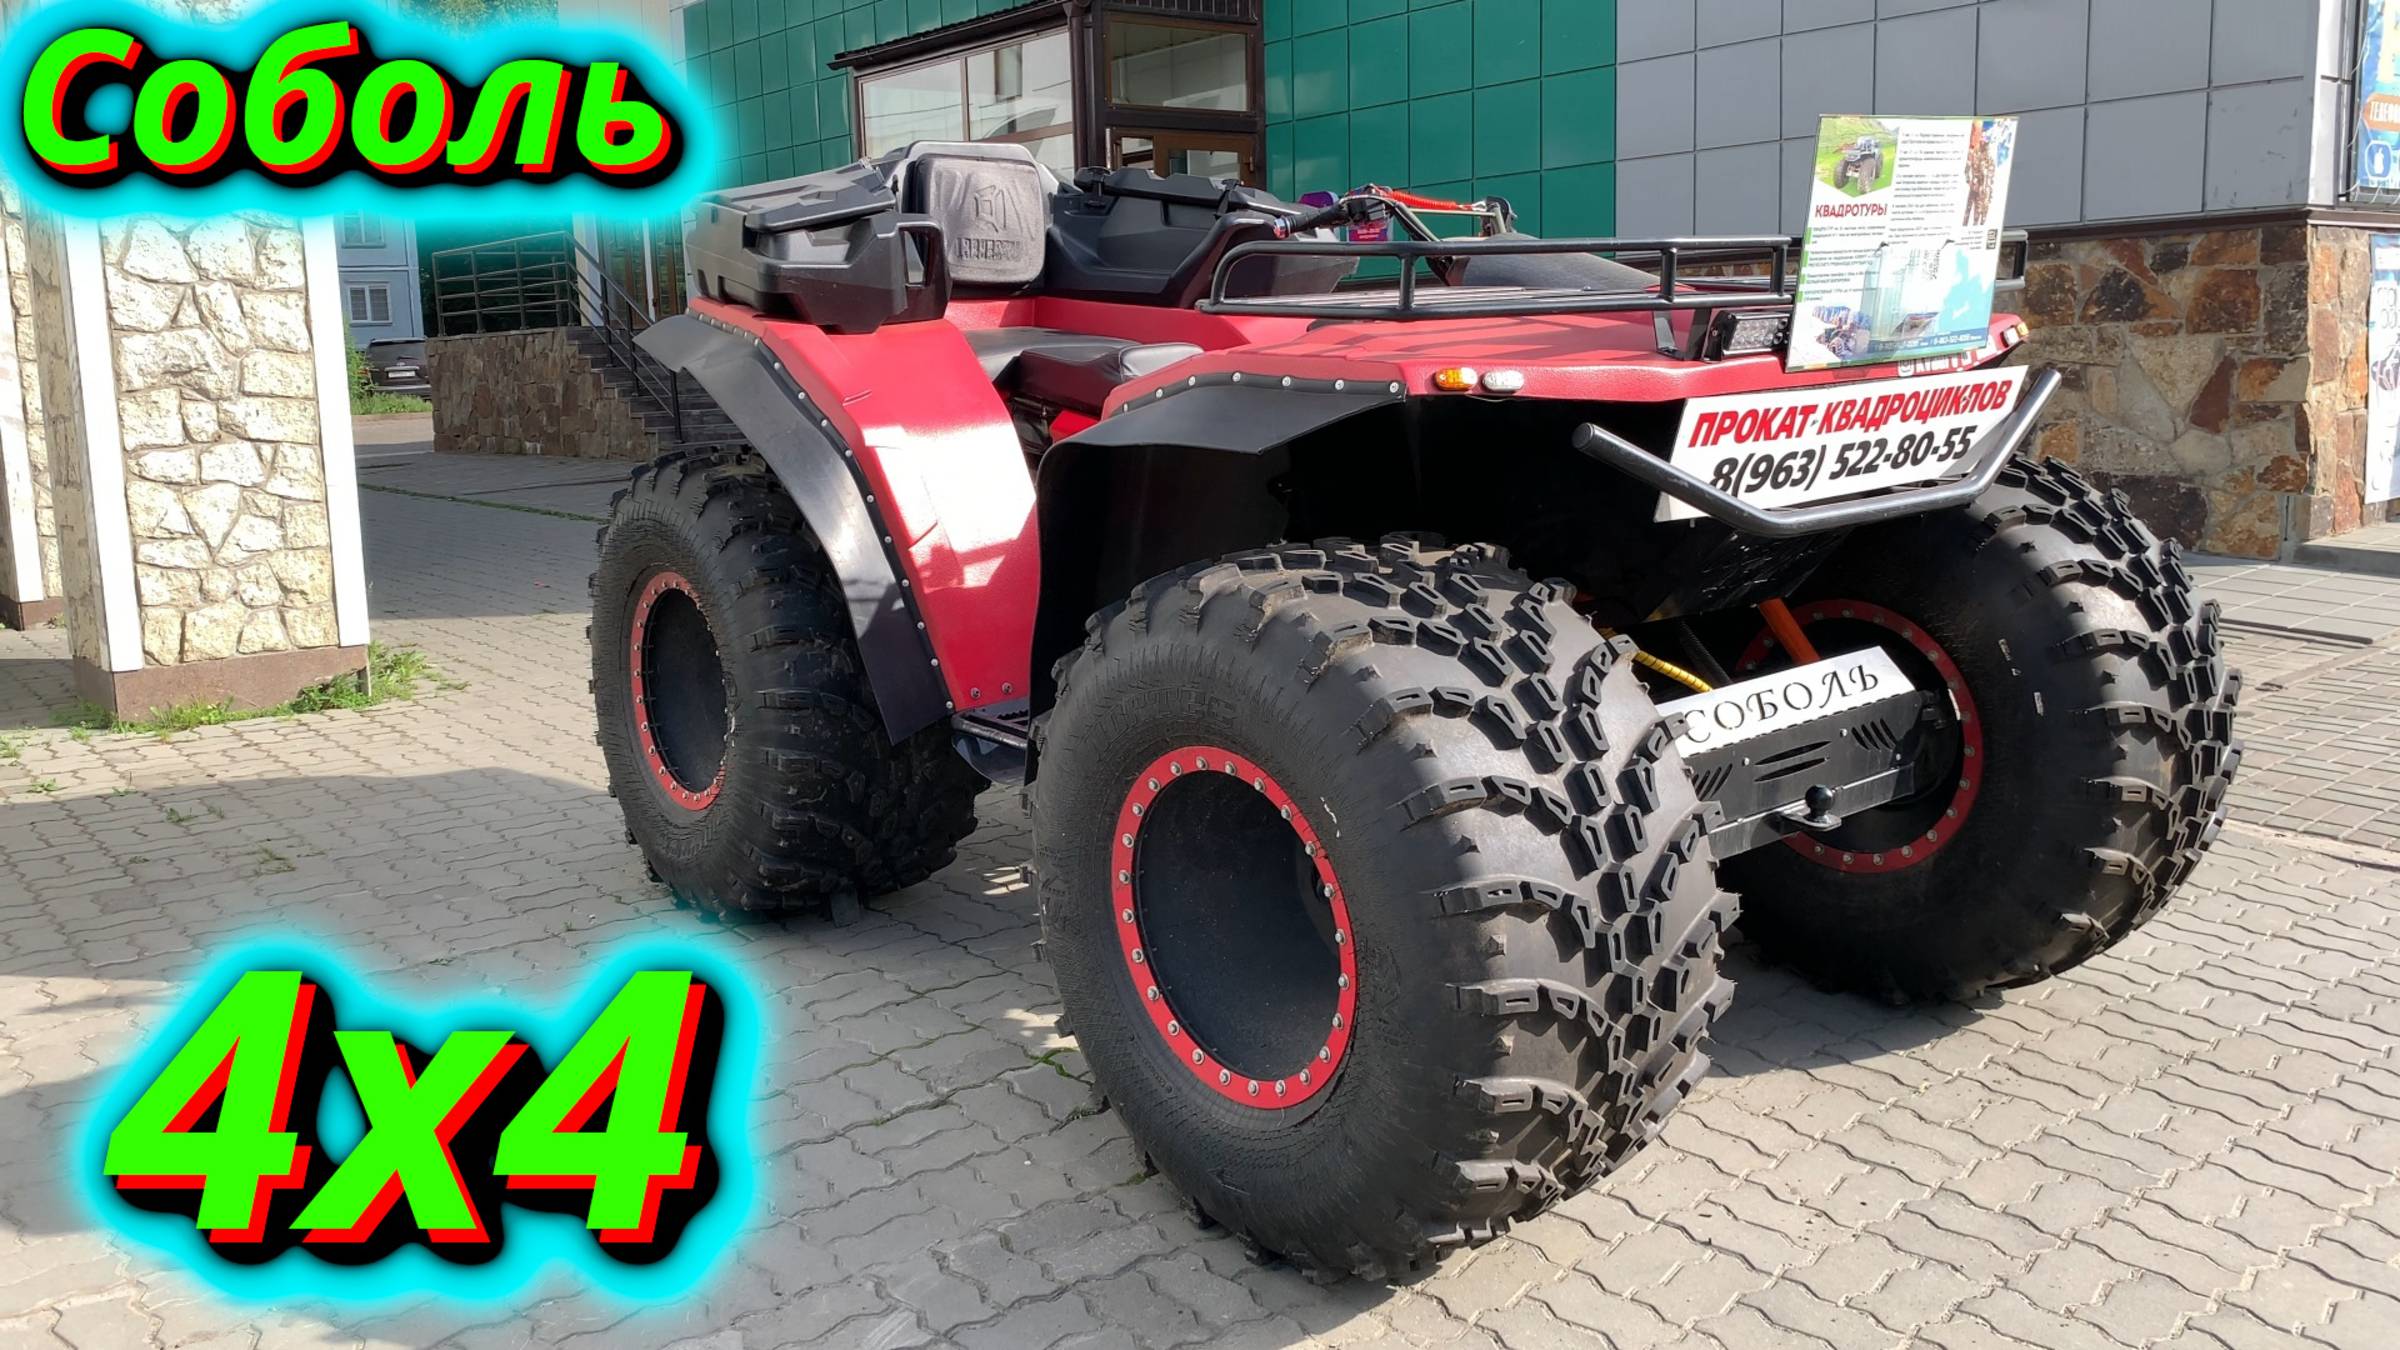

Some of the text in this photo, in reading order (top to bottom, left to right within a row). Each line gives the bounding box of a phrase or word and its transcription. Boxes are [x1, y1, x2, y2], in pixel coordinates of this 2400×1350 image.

[1815, 203, 1887, 218] КВАДРОТУРЫ
[1688, 380, 2012, 448] ПРОКАТ КВАДРОЦИКЛОВ
[1710, 425, 1977, 497] 8(963) 522-80-55
[1682, 665, 1879, 743] СОБОЛЬ
